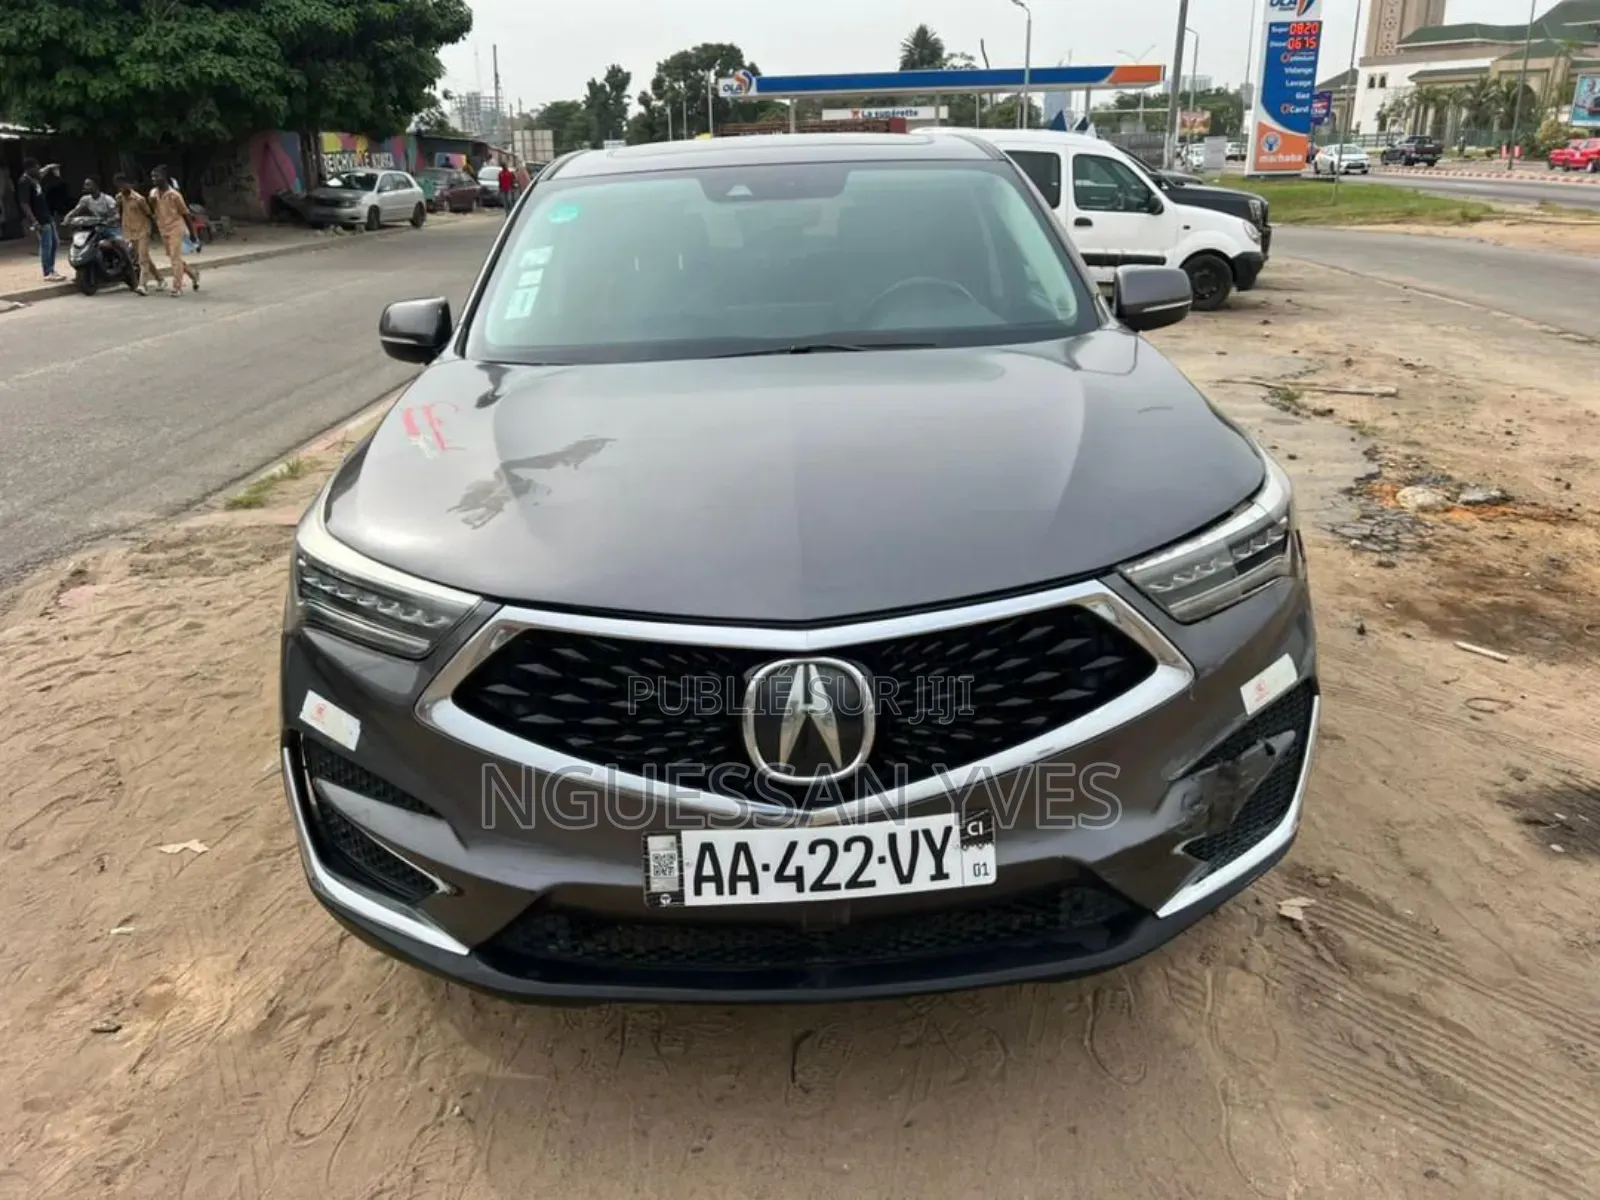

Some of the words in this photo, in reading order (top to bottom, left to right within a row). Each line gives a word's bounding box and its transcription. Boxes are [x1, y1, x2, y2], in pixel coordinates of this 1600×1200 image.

[723, 83, 743, 93] OLA
[862, 109, 872, 118] La
[967, 821, 983, 836] CI
[973, 862, 989, 877] 01
